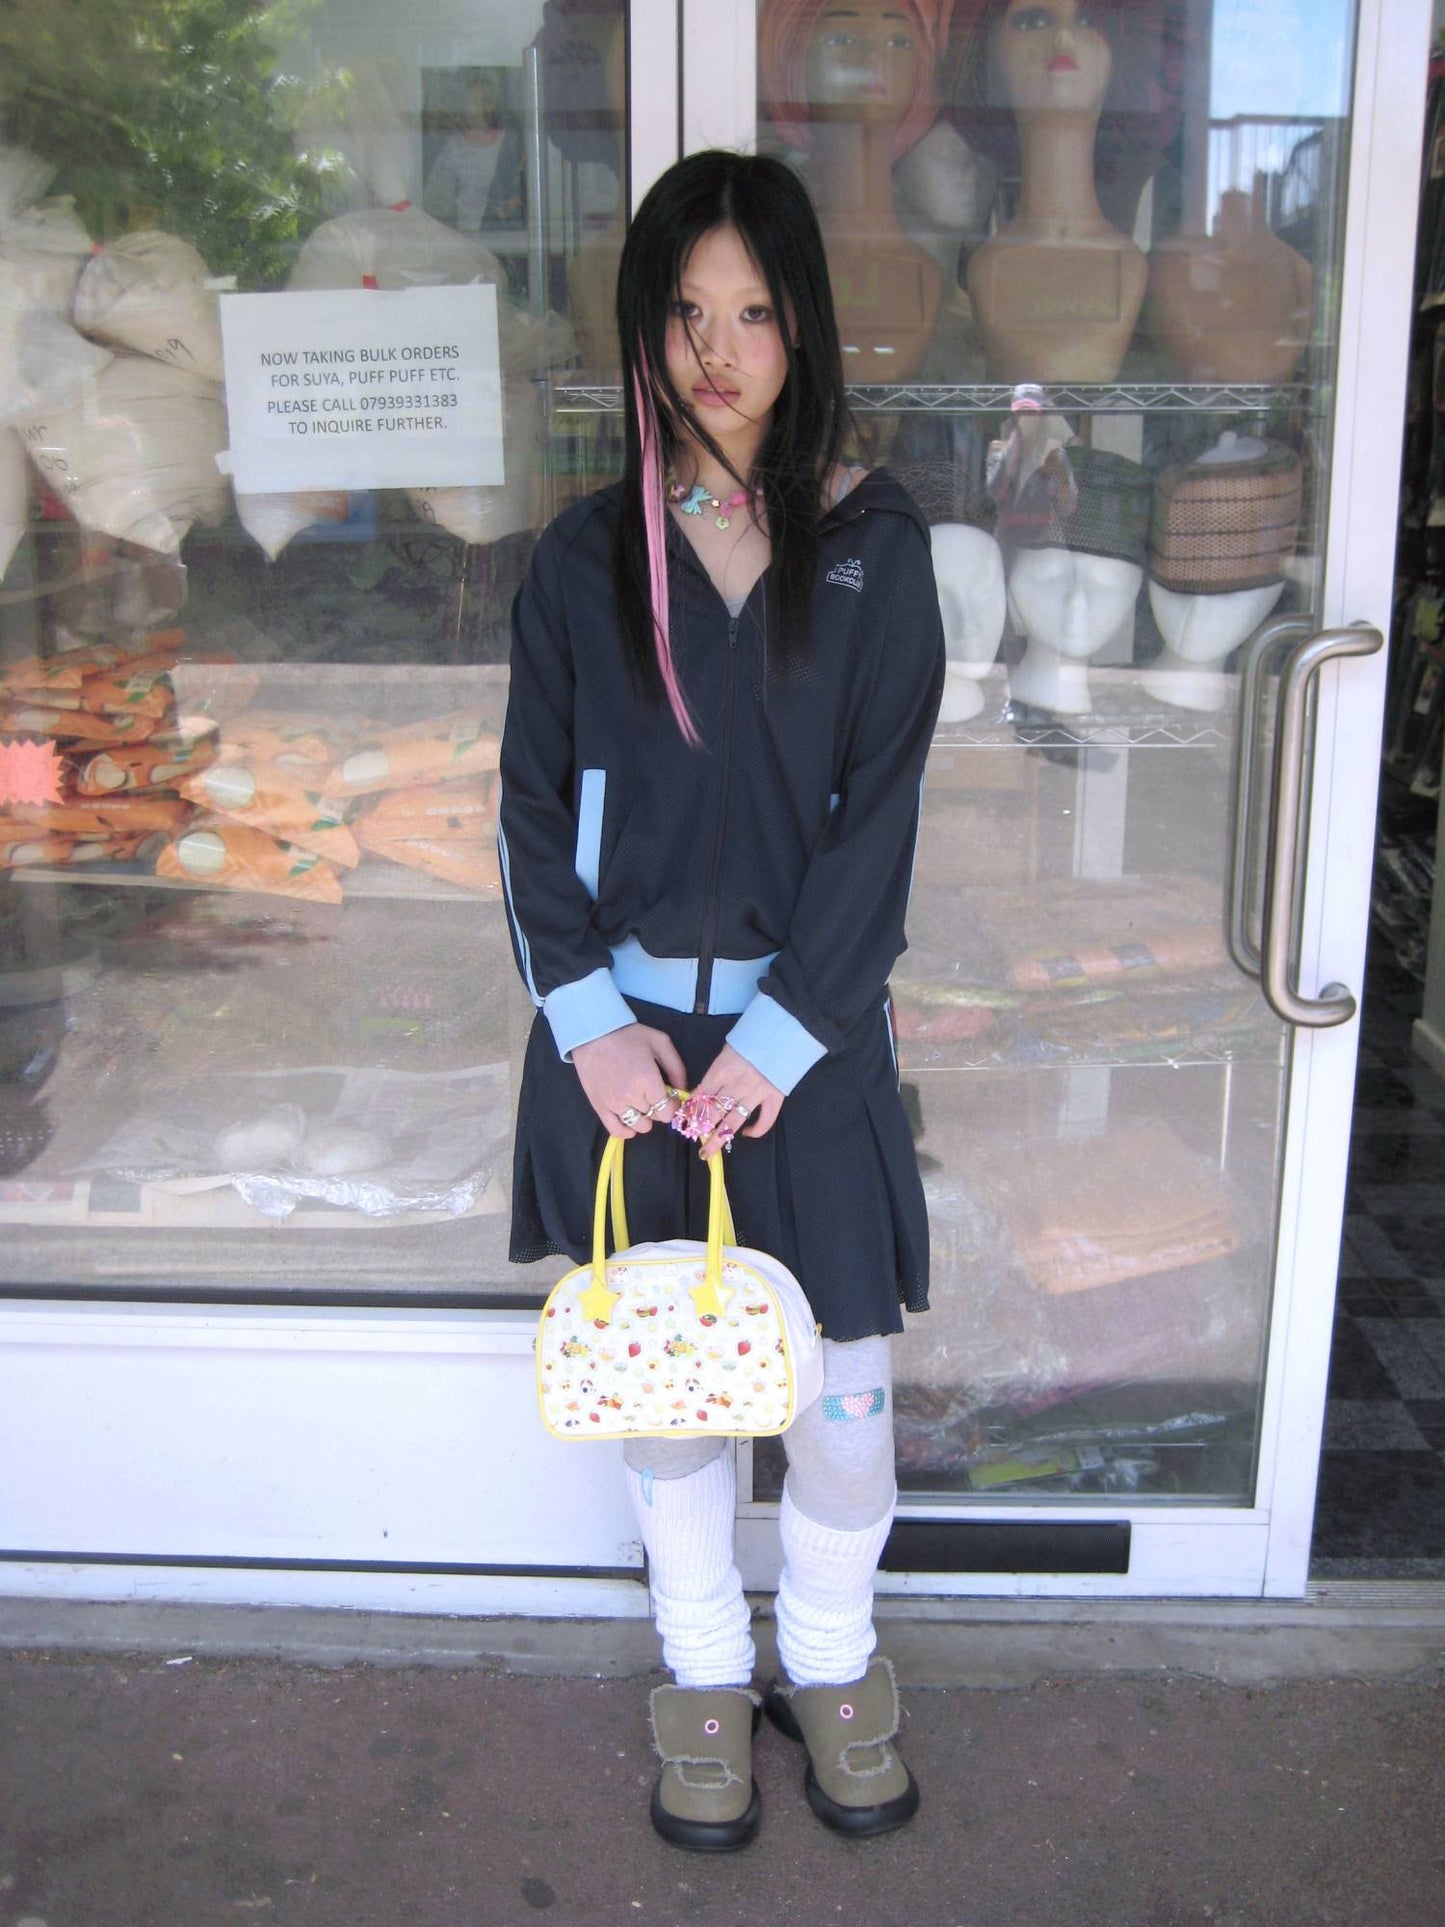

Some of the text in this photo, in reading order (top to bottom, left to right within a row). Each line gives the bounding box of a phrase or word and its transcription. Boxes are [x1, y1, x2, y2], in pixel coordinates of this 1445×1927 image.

[261, 345, 460, 366] NOW TAKING BULK ORDERS
[271, 367, 460, 387] FOR SUYA, PUFF PUFF ETC.
[267, 394, 458, 414] PLEASE CALL 07939331383
[288, 416, 448, 435] TO INQUIRE FURTHER.
